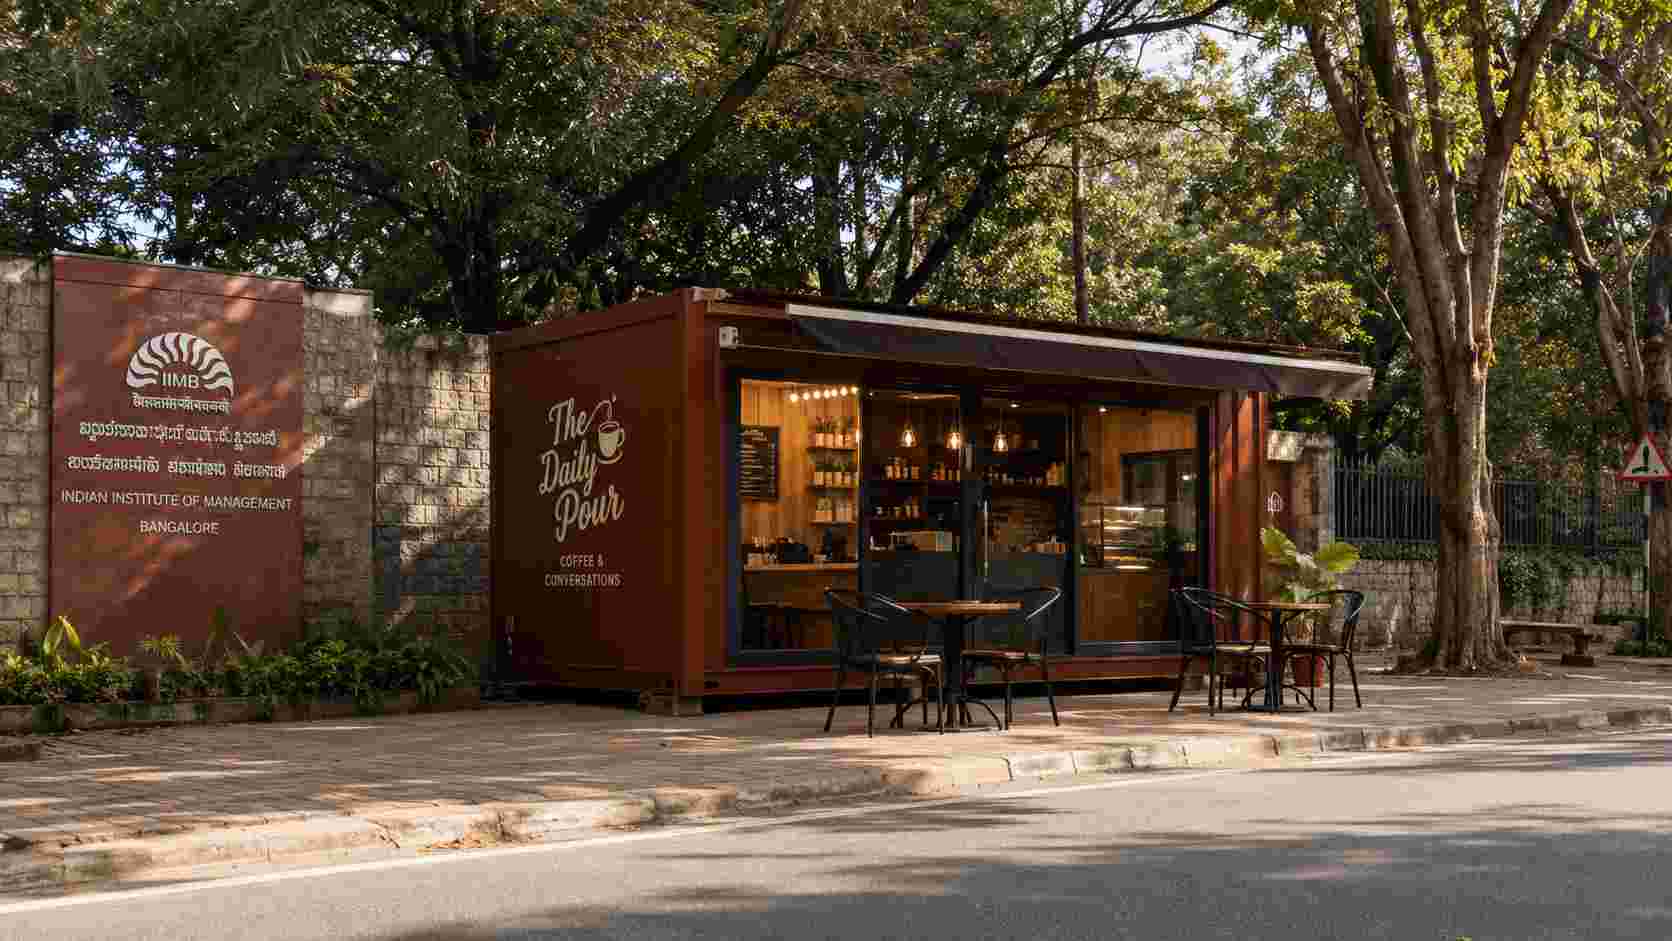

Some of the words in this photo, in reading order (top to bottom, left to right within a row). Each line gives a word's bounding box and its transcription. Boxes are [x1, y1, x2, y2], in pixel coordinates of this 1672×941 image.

[162, 372, 199, 388] IIMB
[548, 397, 593, 446] The
[538, 439, 598, 496] Daily
[61, 490, 108, 504] INDIAN
[112, 491, 179, 506] INSTITUTE
[182, 495, 201, 507] OF
[204, 496, 293, 511] MANAGEMENT
[554, 484, 625, 543] Pour
[140, 520, 220, 535] BANGALORE
[560, 554, 594, 568] COFFEE
[598, 554, 604, 568] &
[544, 574, 621, 587] CONVERSATIONS
